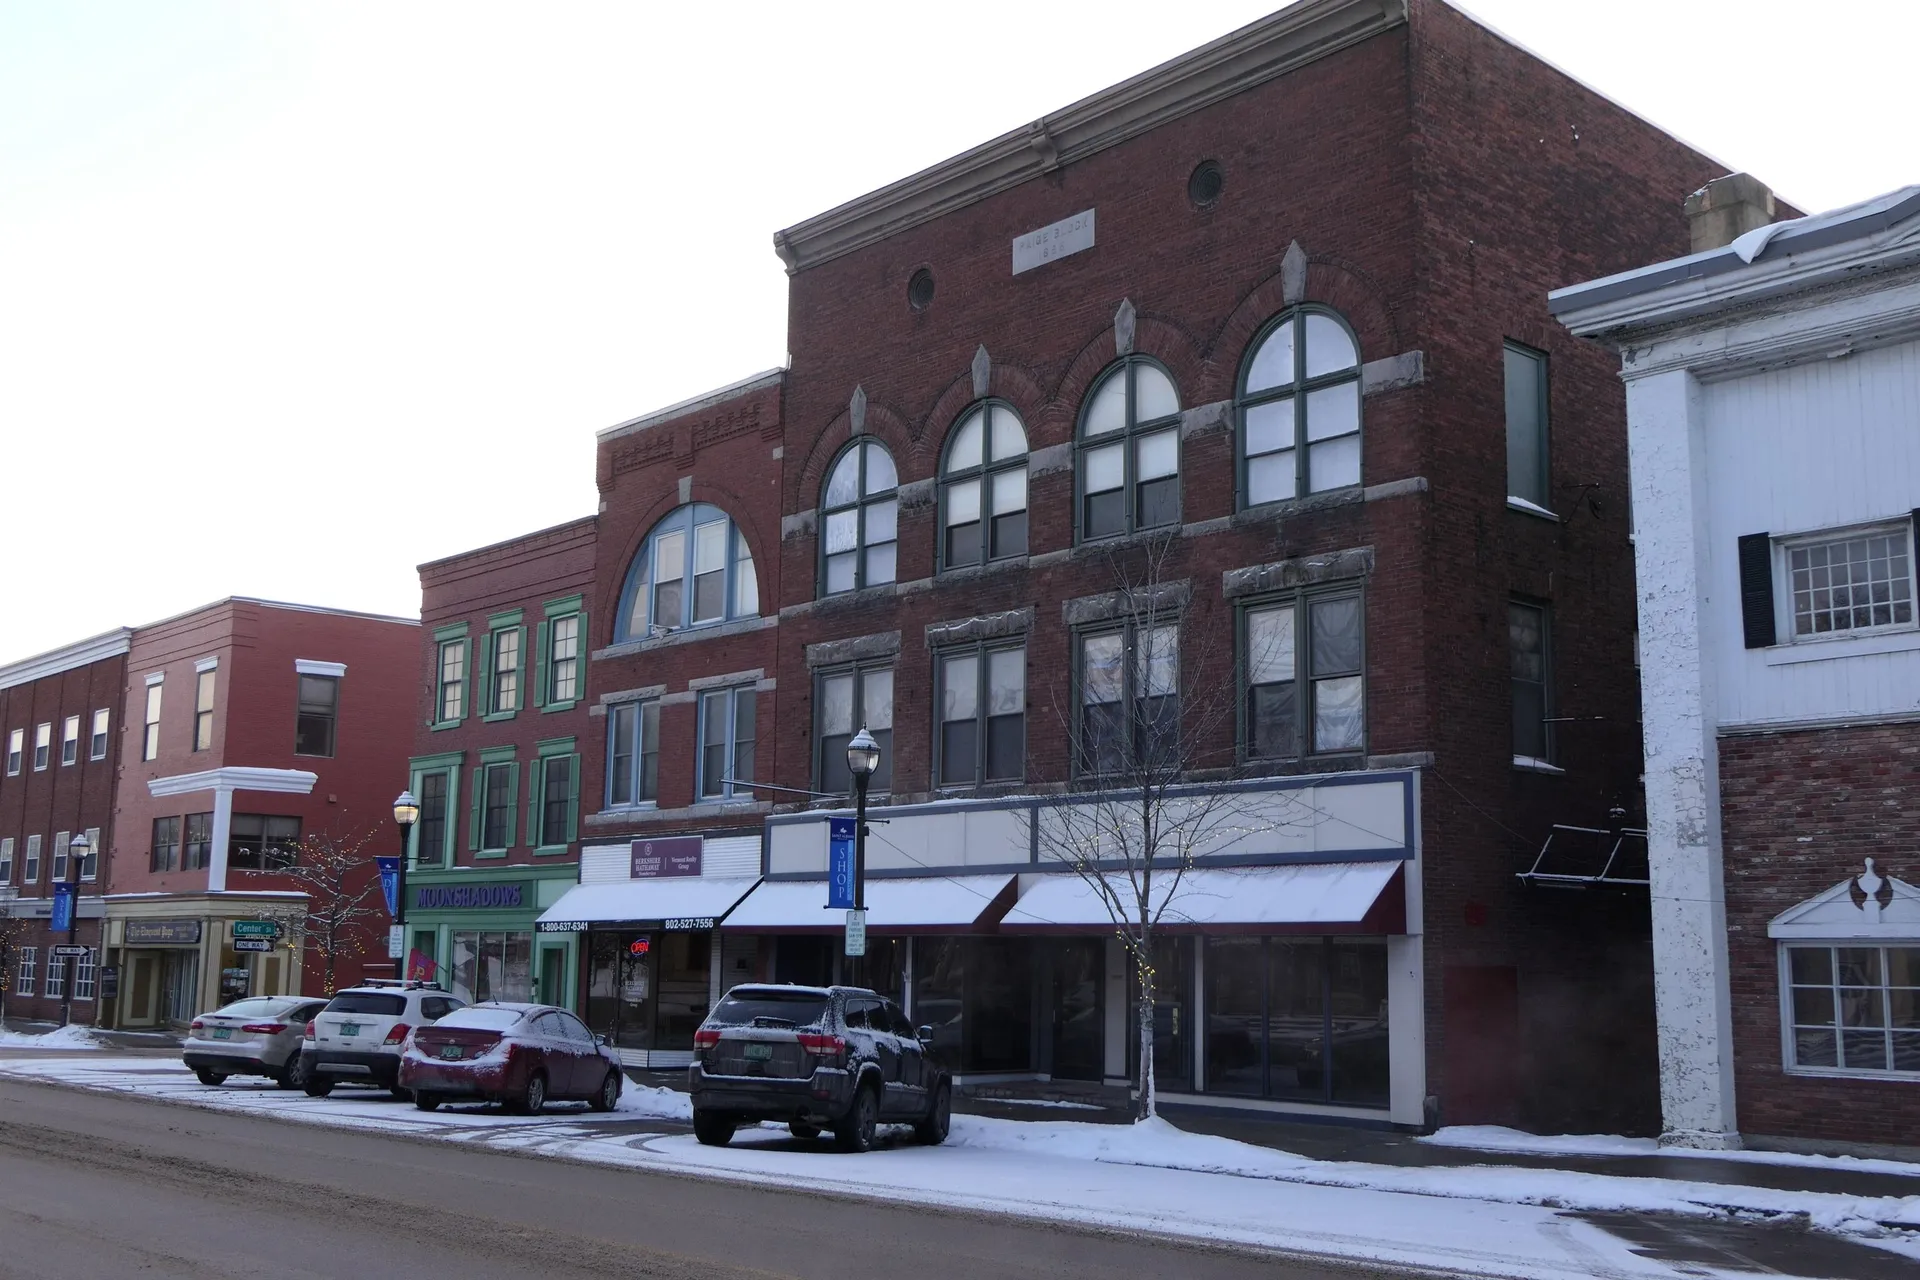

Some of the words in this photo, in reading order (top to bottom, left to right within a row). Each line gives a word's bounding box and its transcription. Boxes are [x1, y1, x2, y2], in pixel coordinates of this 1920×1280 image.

[1019, 232, 1049, 252] PAIGE
[1054, 216, 1088, 239] BLOCK
[635, 857, 661, 865] BERKSHIRE
[635, 864, 660, 872] HATHAWAY
[836, 847, 847, 898] SHOP
[418, 885, 522, 908] MOONSHADOWS
[853, 913, 858, 921] 2
[237, 924, 262, 933] Center
[541, 921, 588, 932] 1-800-637-6341
[665, 918, 714, 930] 802-527-7556
[631, 942, 650, 953] OPEN
